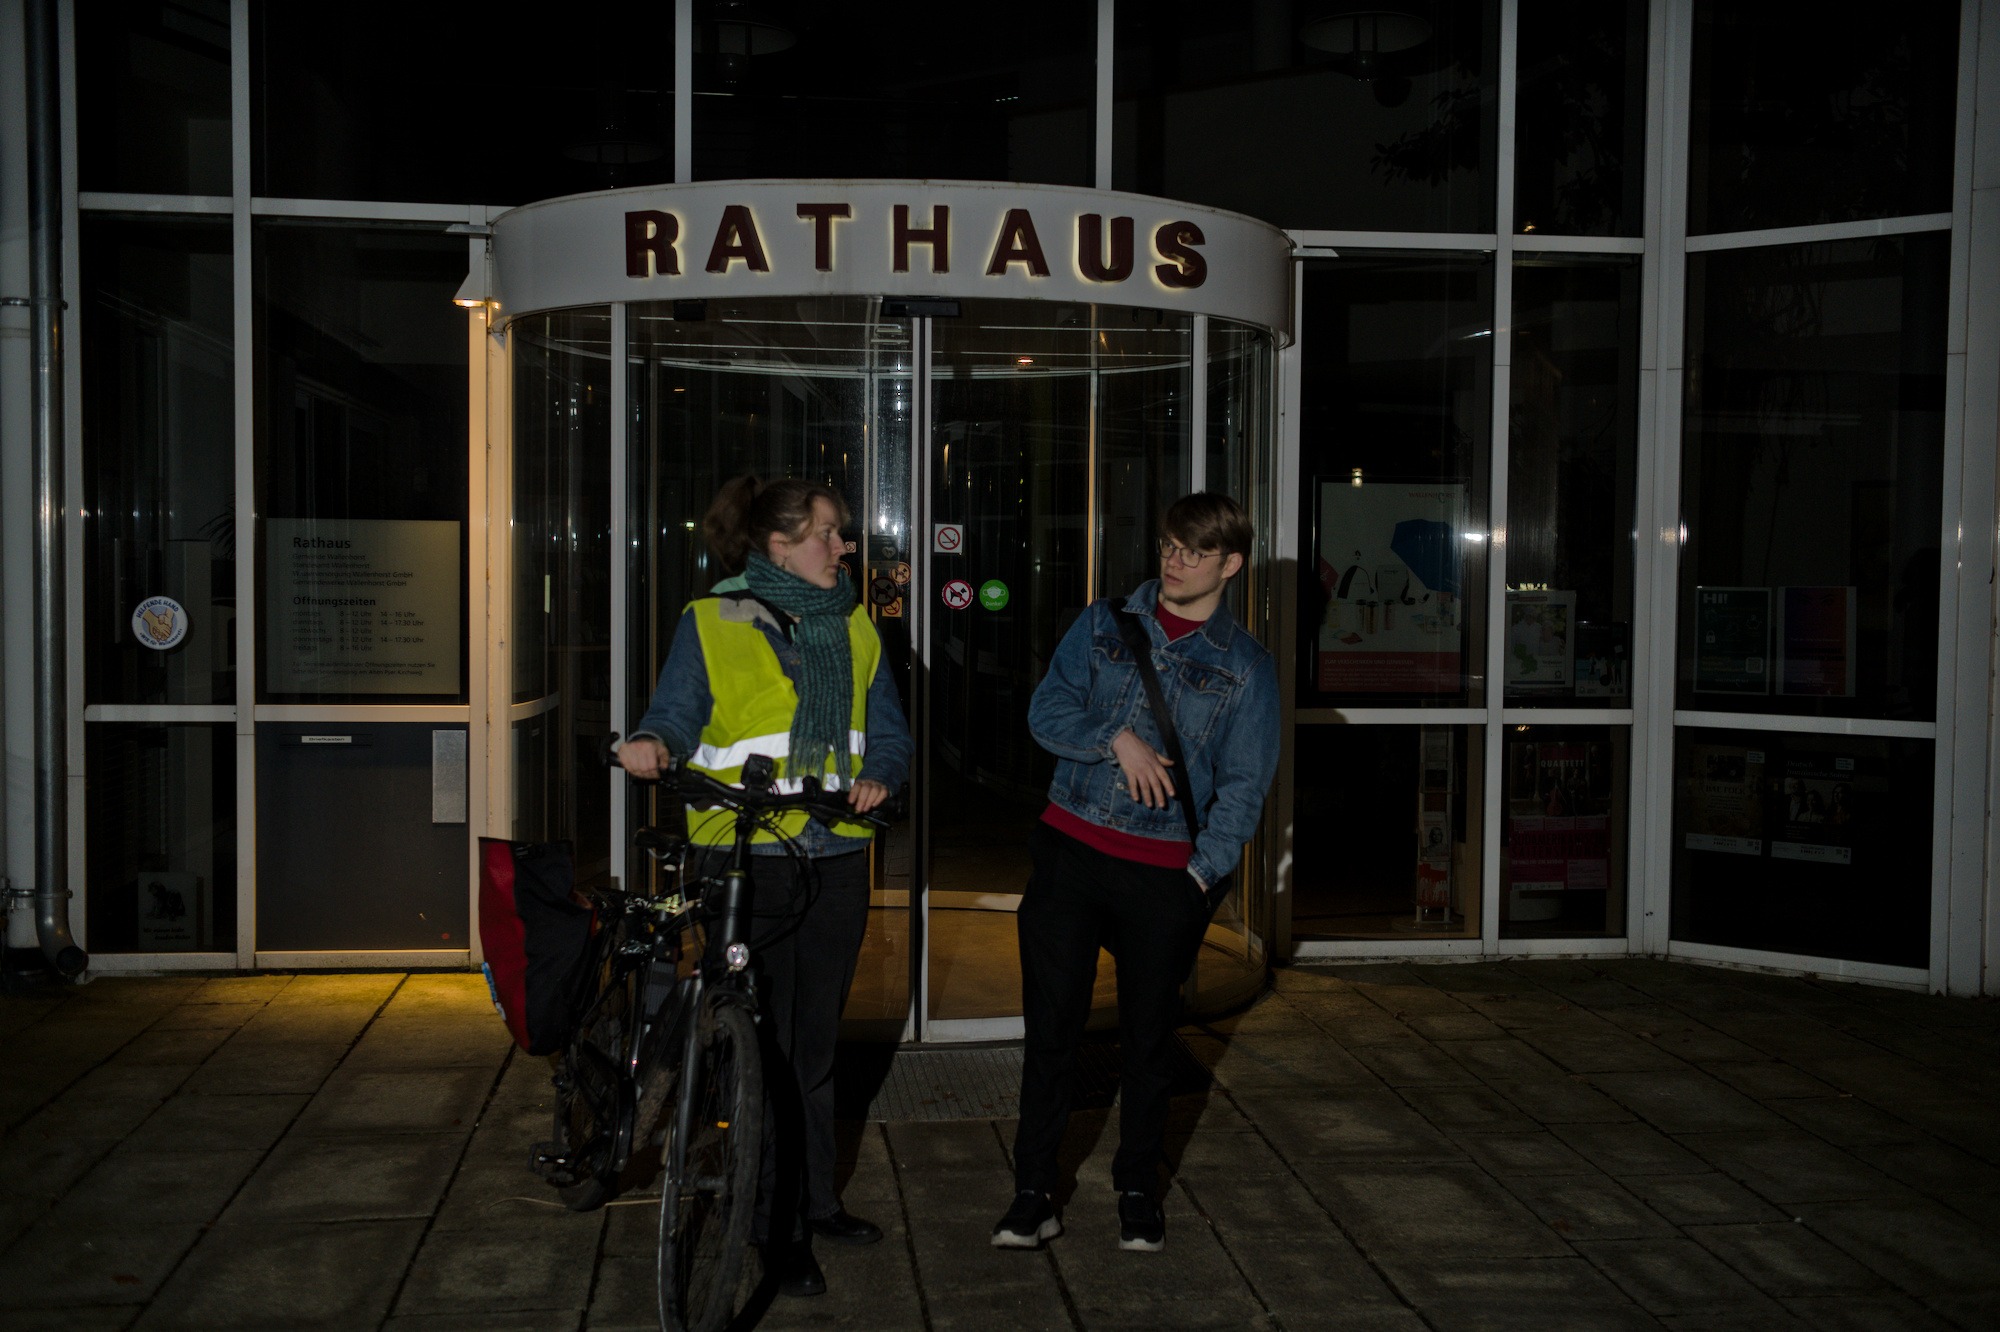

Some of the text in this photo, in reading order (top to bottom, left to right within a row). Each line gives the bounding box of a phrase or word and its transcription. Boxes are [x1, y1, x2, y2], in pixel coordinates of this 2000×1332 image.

[624, 203, 1208, 289] RATHAUS
[293, 537, 351, 549] Rathaus
[1703, 593, 1728, 604] HI!
